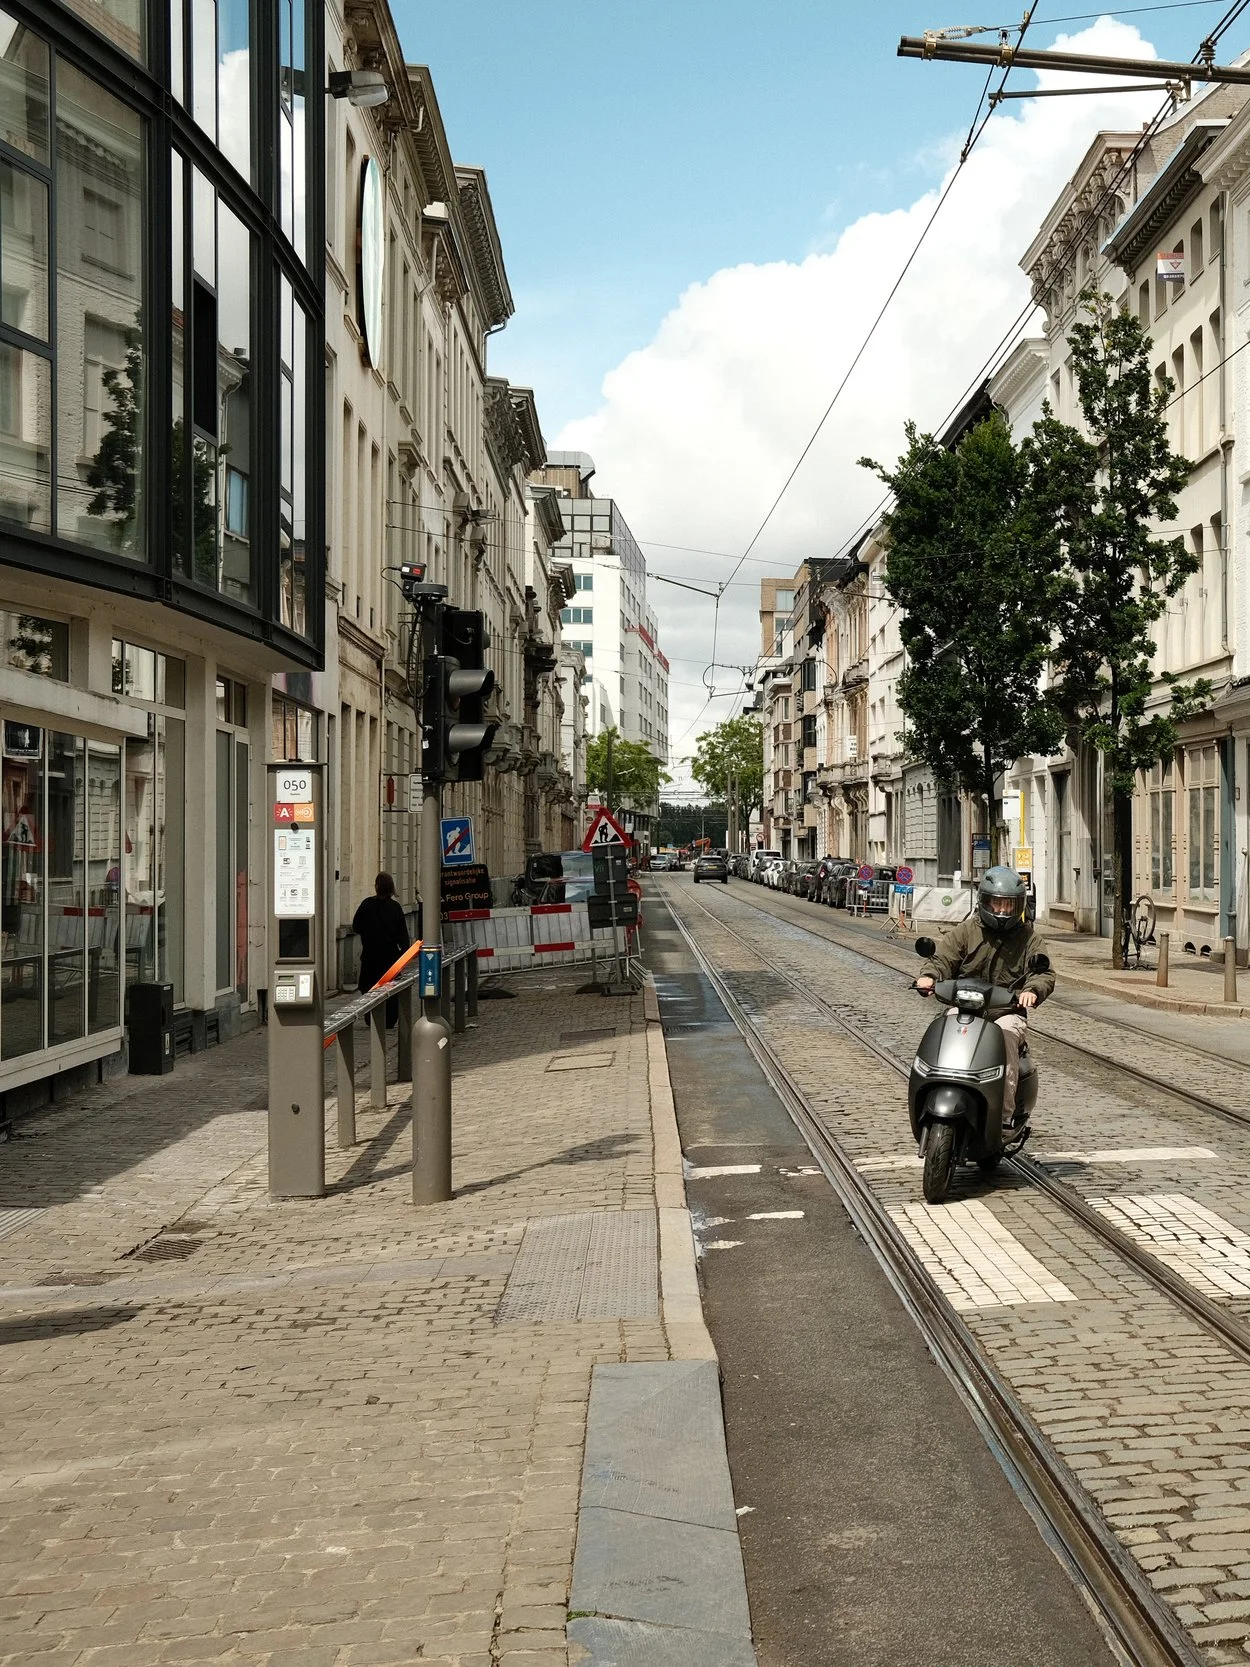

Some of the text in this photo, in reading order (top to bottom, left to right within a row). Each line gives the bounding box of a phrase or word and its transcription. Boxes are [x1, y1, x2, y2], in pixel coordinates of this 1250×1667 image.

[283, 780, 307, 791] 050
[279, 807, 290, 818] A
[441, 867, 485, 877] rantwoordelijke
[446, 892, 489, 902] Fero Group
